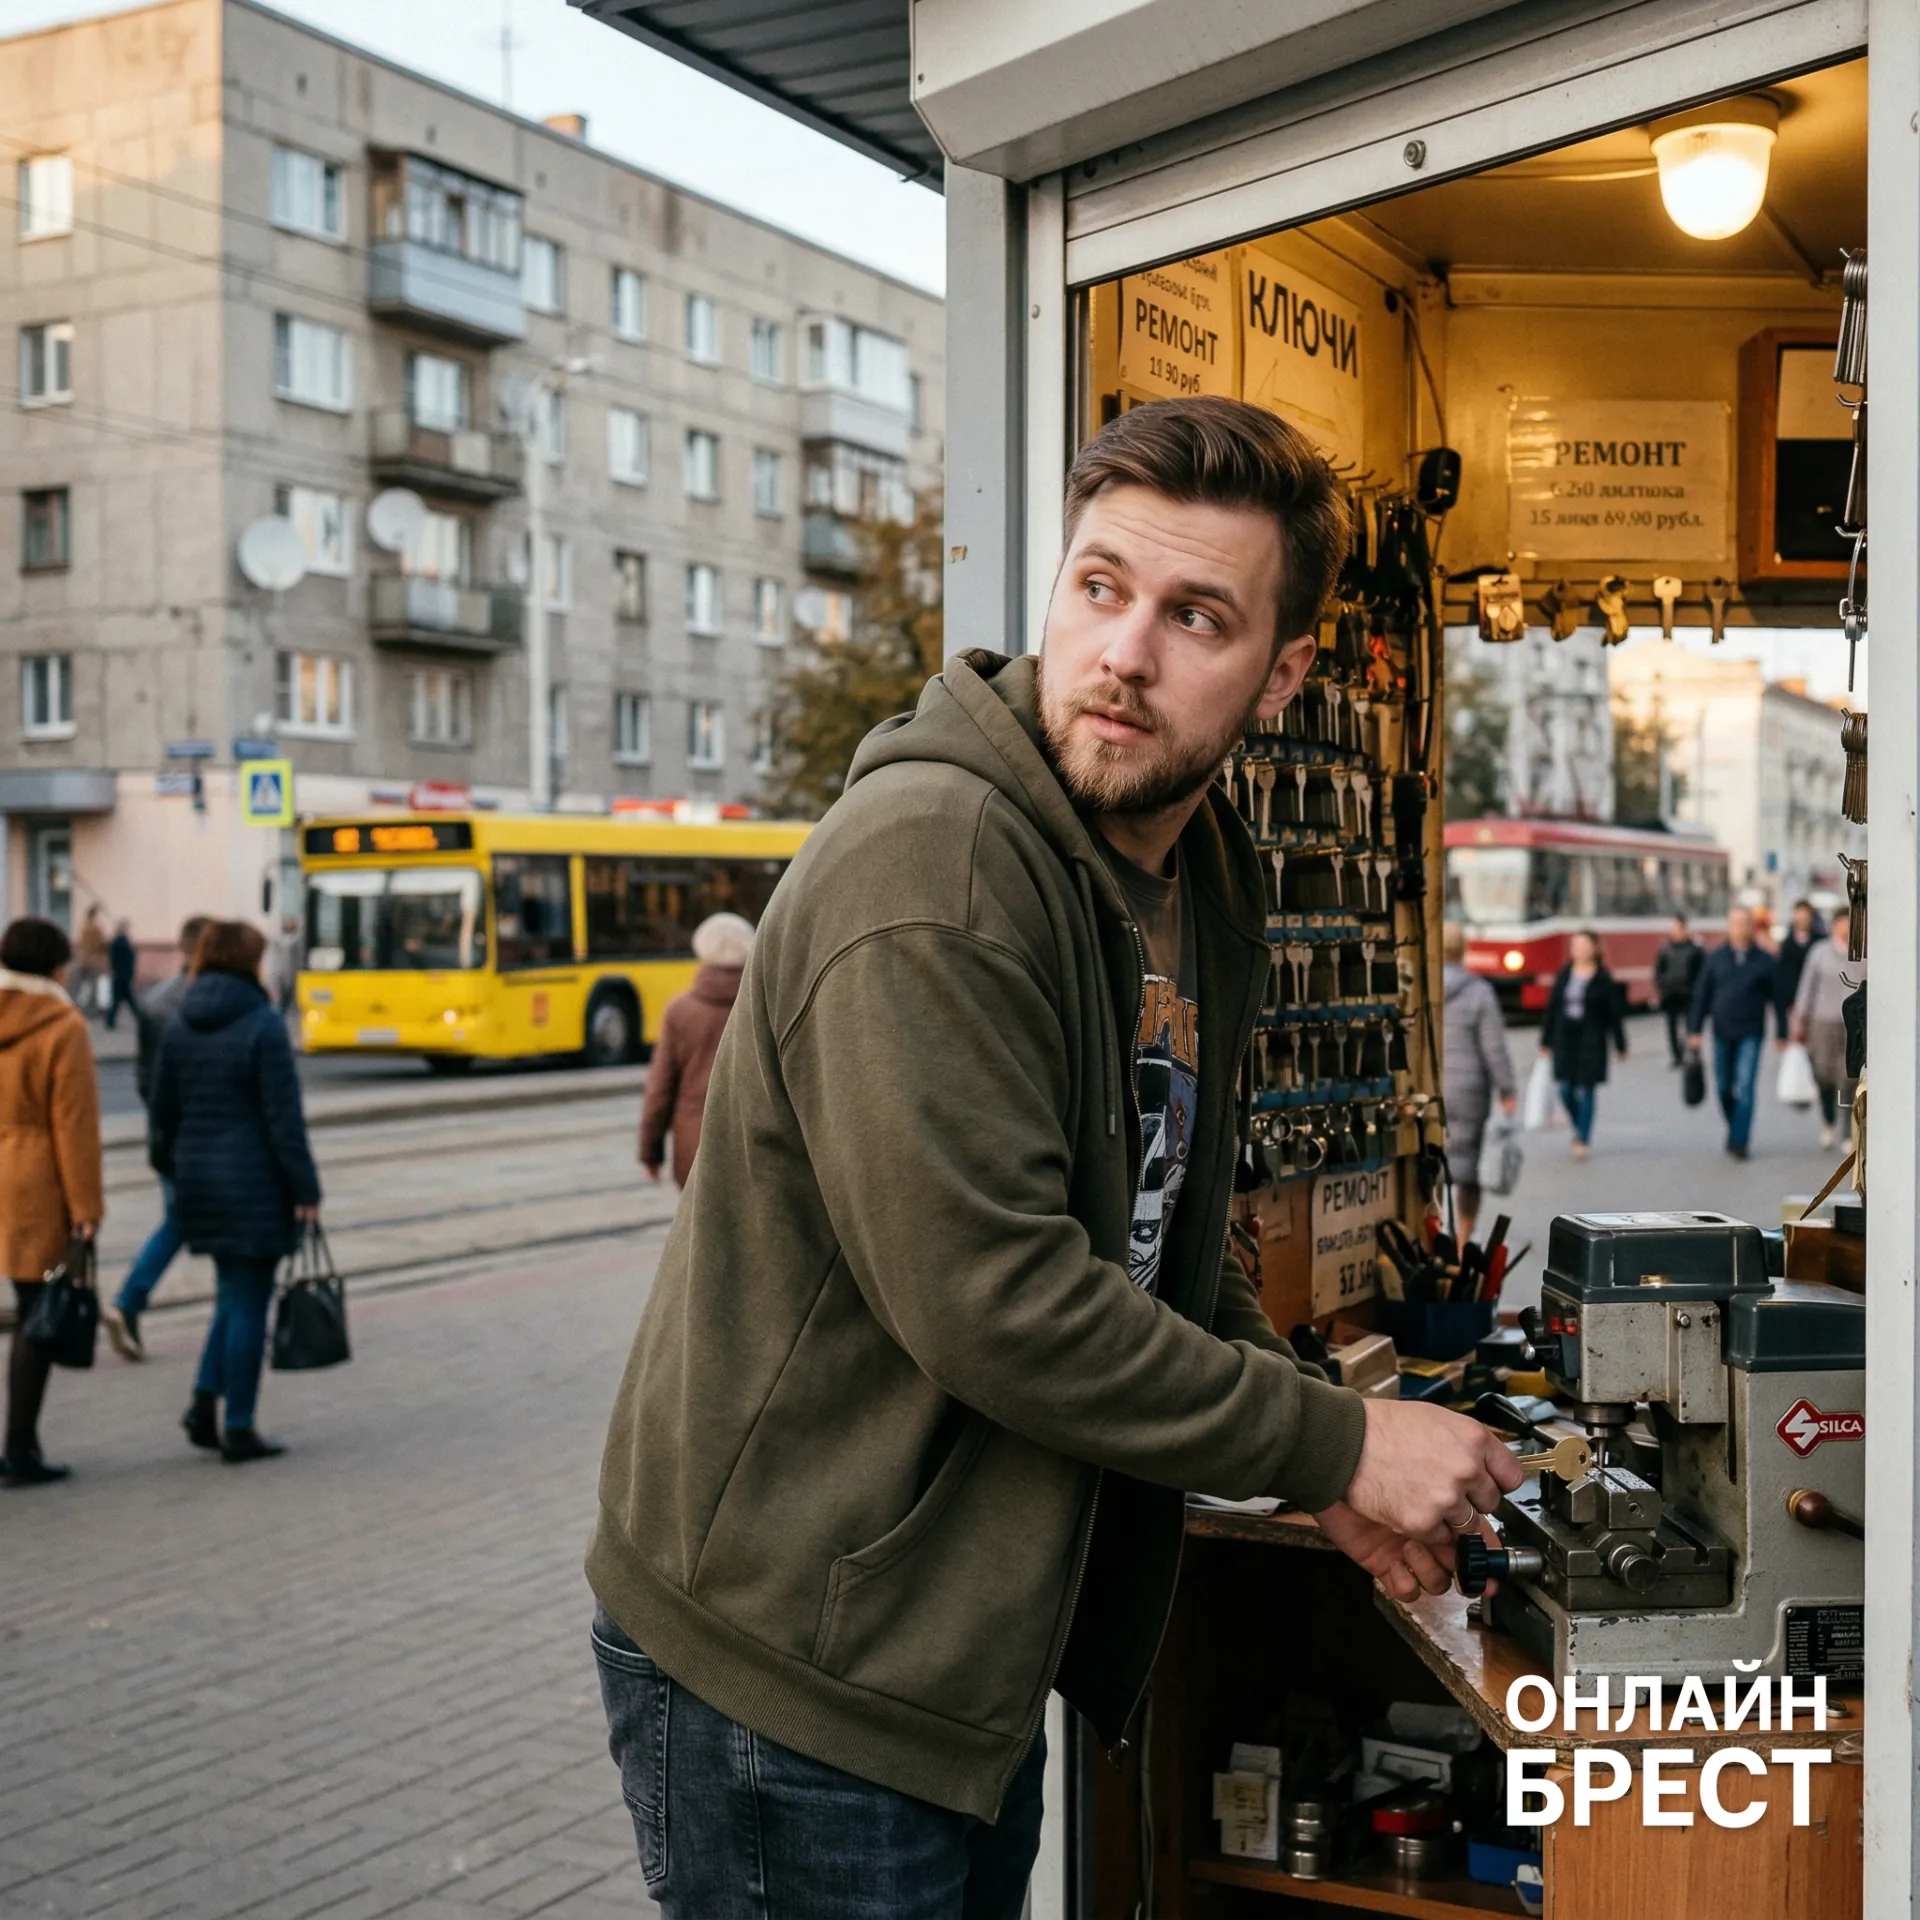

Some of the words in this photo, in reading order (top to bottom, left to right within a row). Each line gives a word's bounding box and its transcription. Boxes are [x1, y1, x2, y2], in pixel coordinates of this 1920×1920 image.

[1136, 297, 1218, 366] РЕМОНТ
[1249, 269, 1358, 379] КЛЮЧИ
[1556, 441, 1687, 467] РЕМОНТ
[1323, 1171, 1389, 1215] РЕМОНТ
[1819, 1420, 1863, 1433] SILCA
